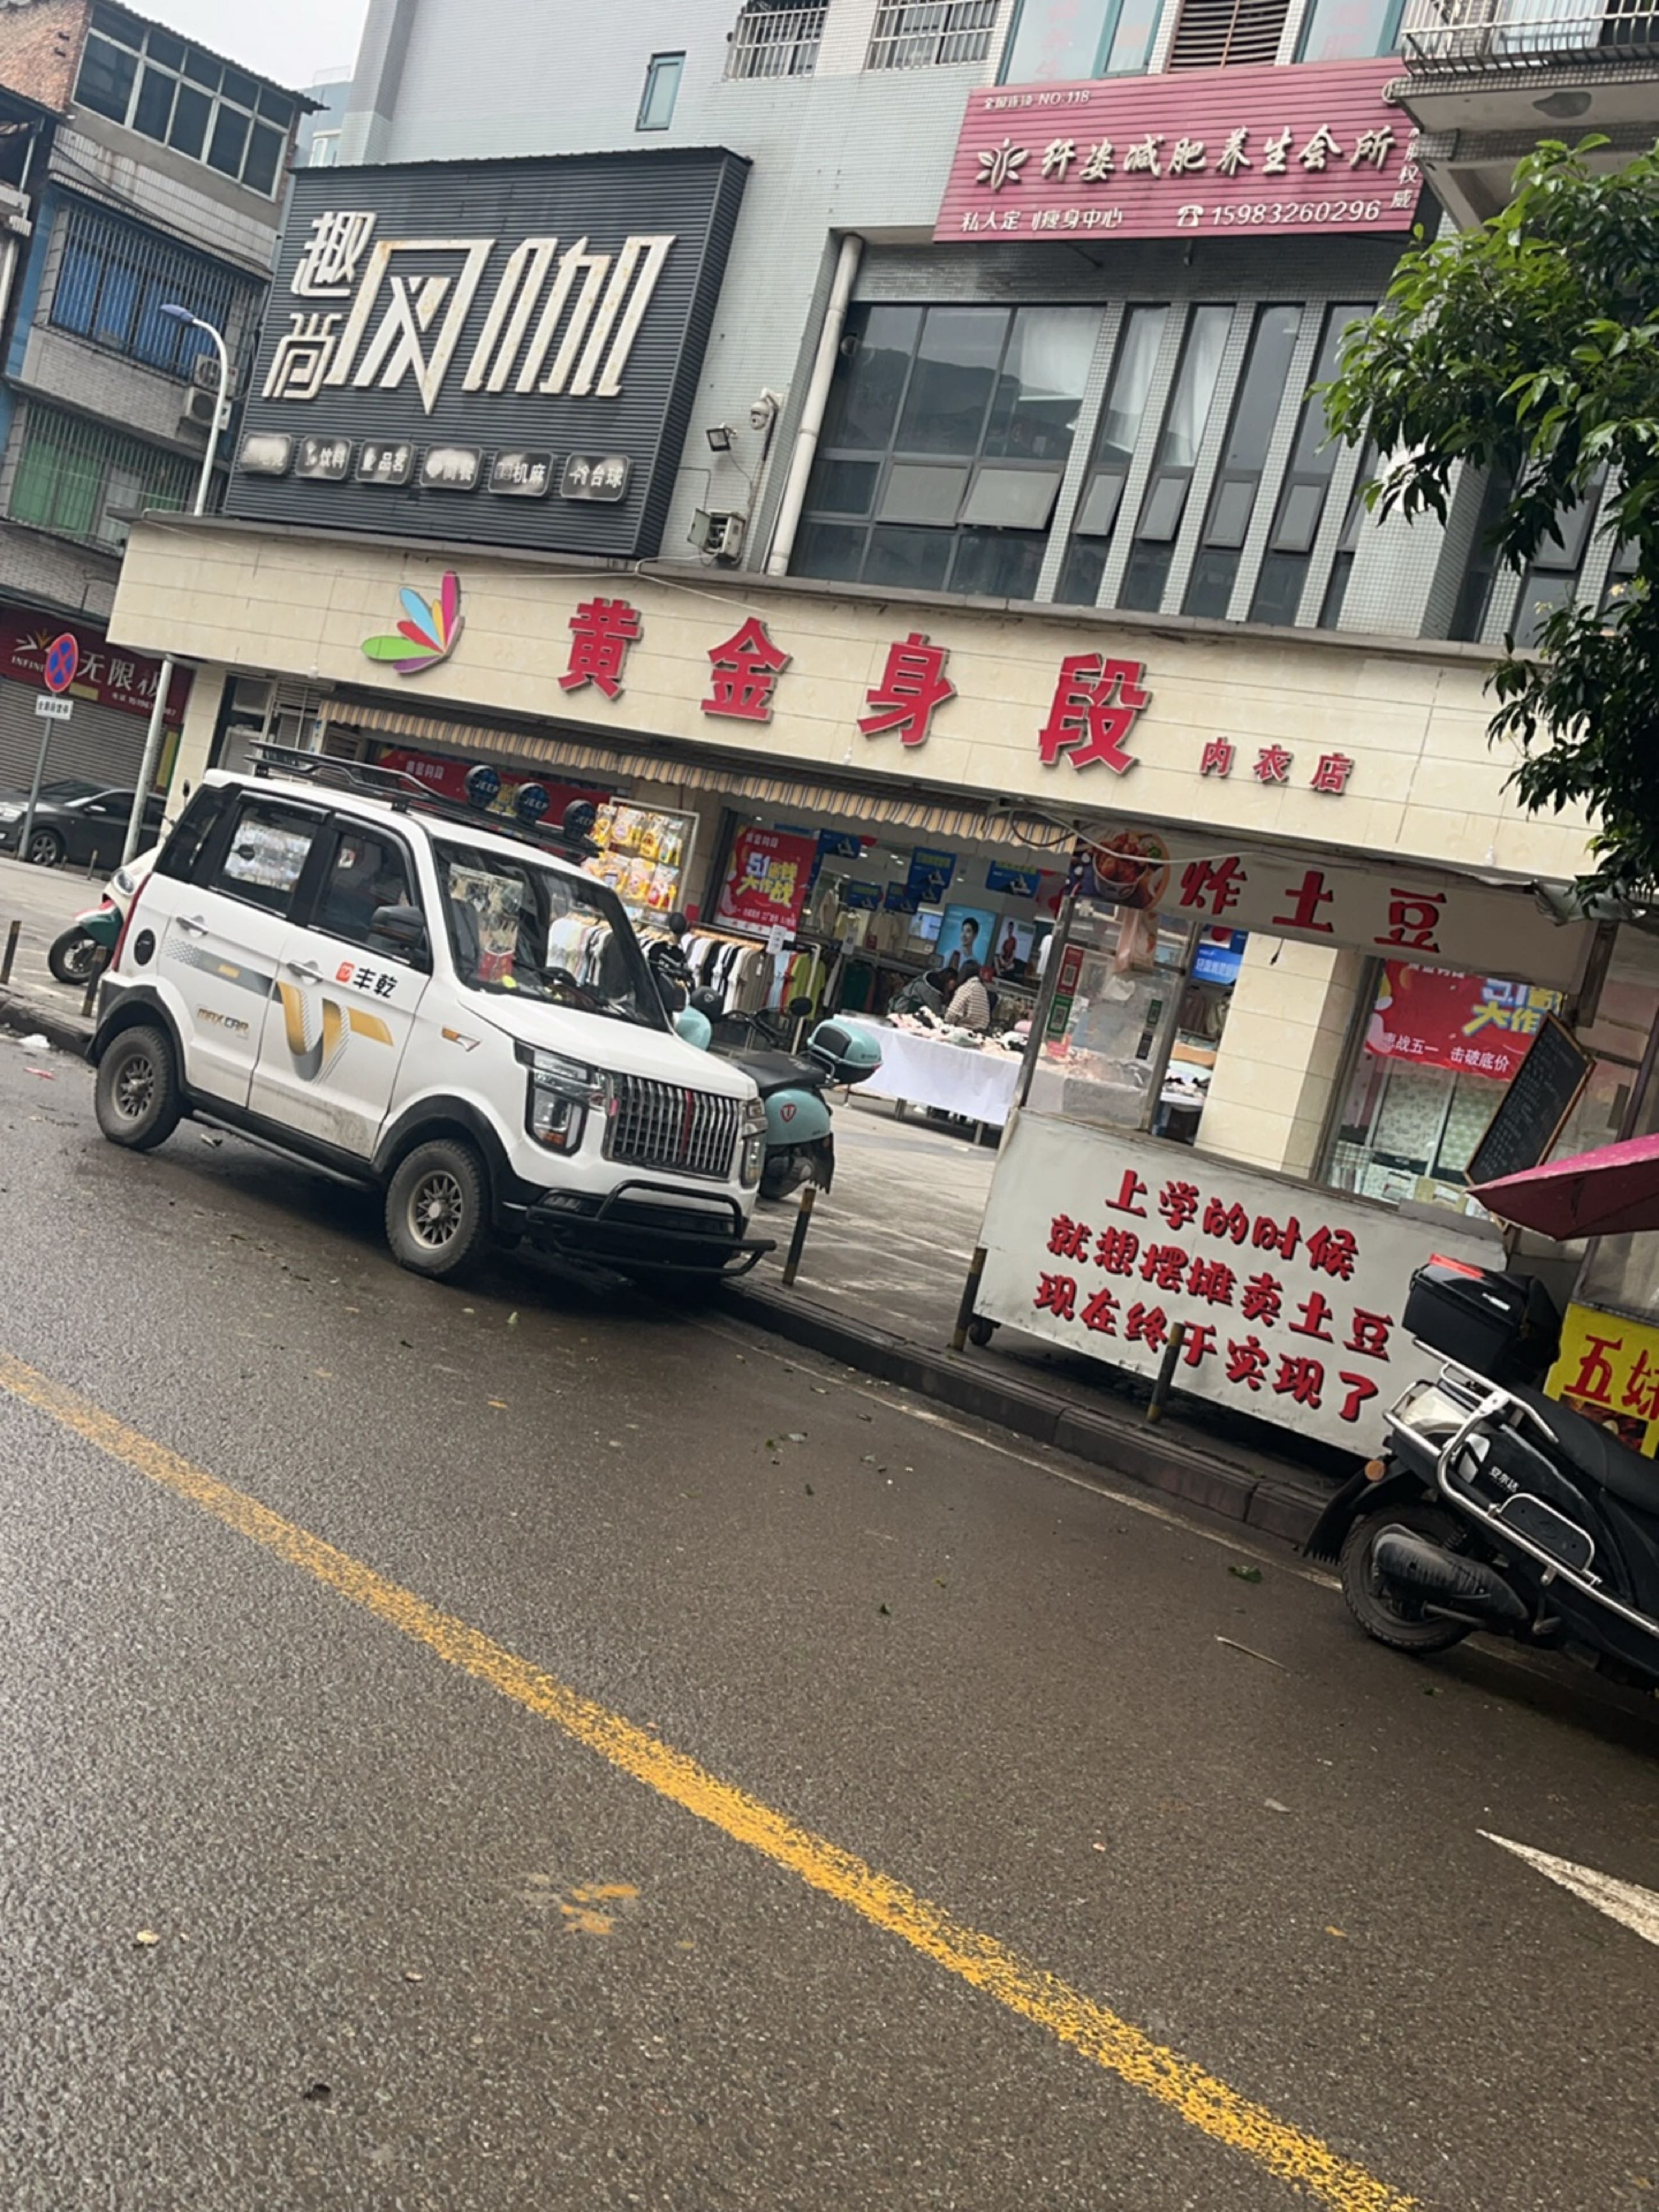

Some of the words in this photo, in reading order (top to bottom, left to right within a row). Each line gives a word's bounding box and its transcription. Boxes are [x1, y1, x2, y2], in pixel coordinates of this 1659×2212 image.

[962, 207, 1123, 232] 私人定瘦身中心
[1210, 201, 1382, 227] 15983260296
[262, 211, 378, 400] 趣尚
[322, 235, 677, 415] 网咖
[557, 597, 1153, 775] 黄金身段
[1199, 736, 1355, 796] 内衣店
[1179, 856, 1447, 953] 炸土豆
[1046, 1214, 1394, 1361] 就想摆摊卖土豆
[1105, 1169, 1359, 1279] 上学的时候
[1034, 1271, 1379, 1422] 现在终于实现了
